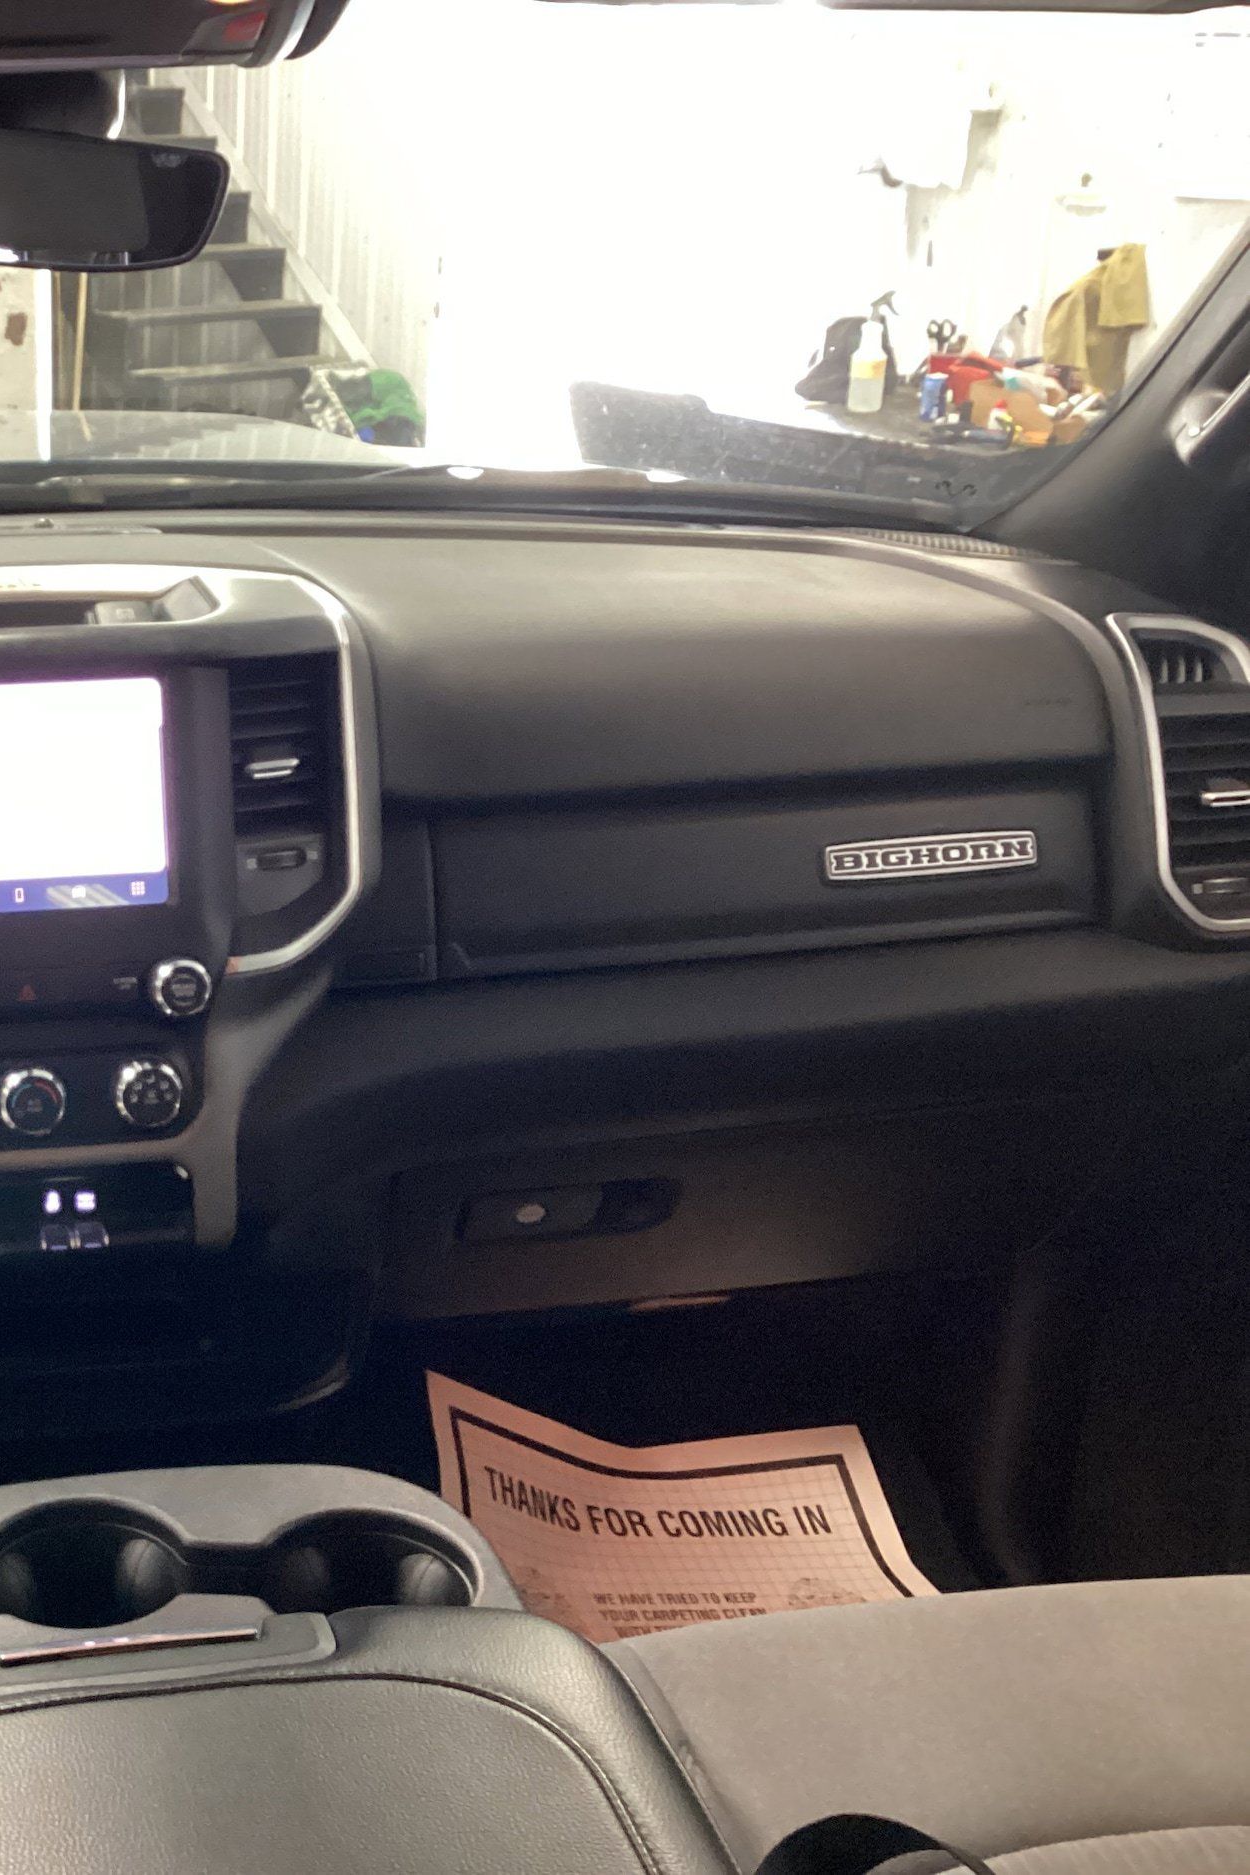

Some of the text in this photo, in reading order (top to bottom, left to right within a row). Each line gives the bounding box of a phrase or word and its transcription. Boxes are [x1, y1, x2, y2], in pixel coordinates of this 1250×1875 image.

[830, 838, 1033, 873] BIGHORN
[485, 1465, 832, 1538] THANKS FOR COMING IN
[593, 1592, 757, 1605] WE HAVE TRIED TO KEEP
[599, 1609, 640, 1622] YOUR
[642, 1609, 721, 1621] CARPETING
